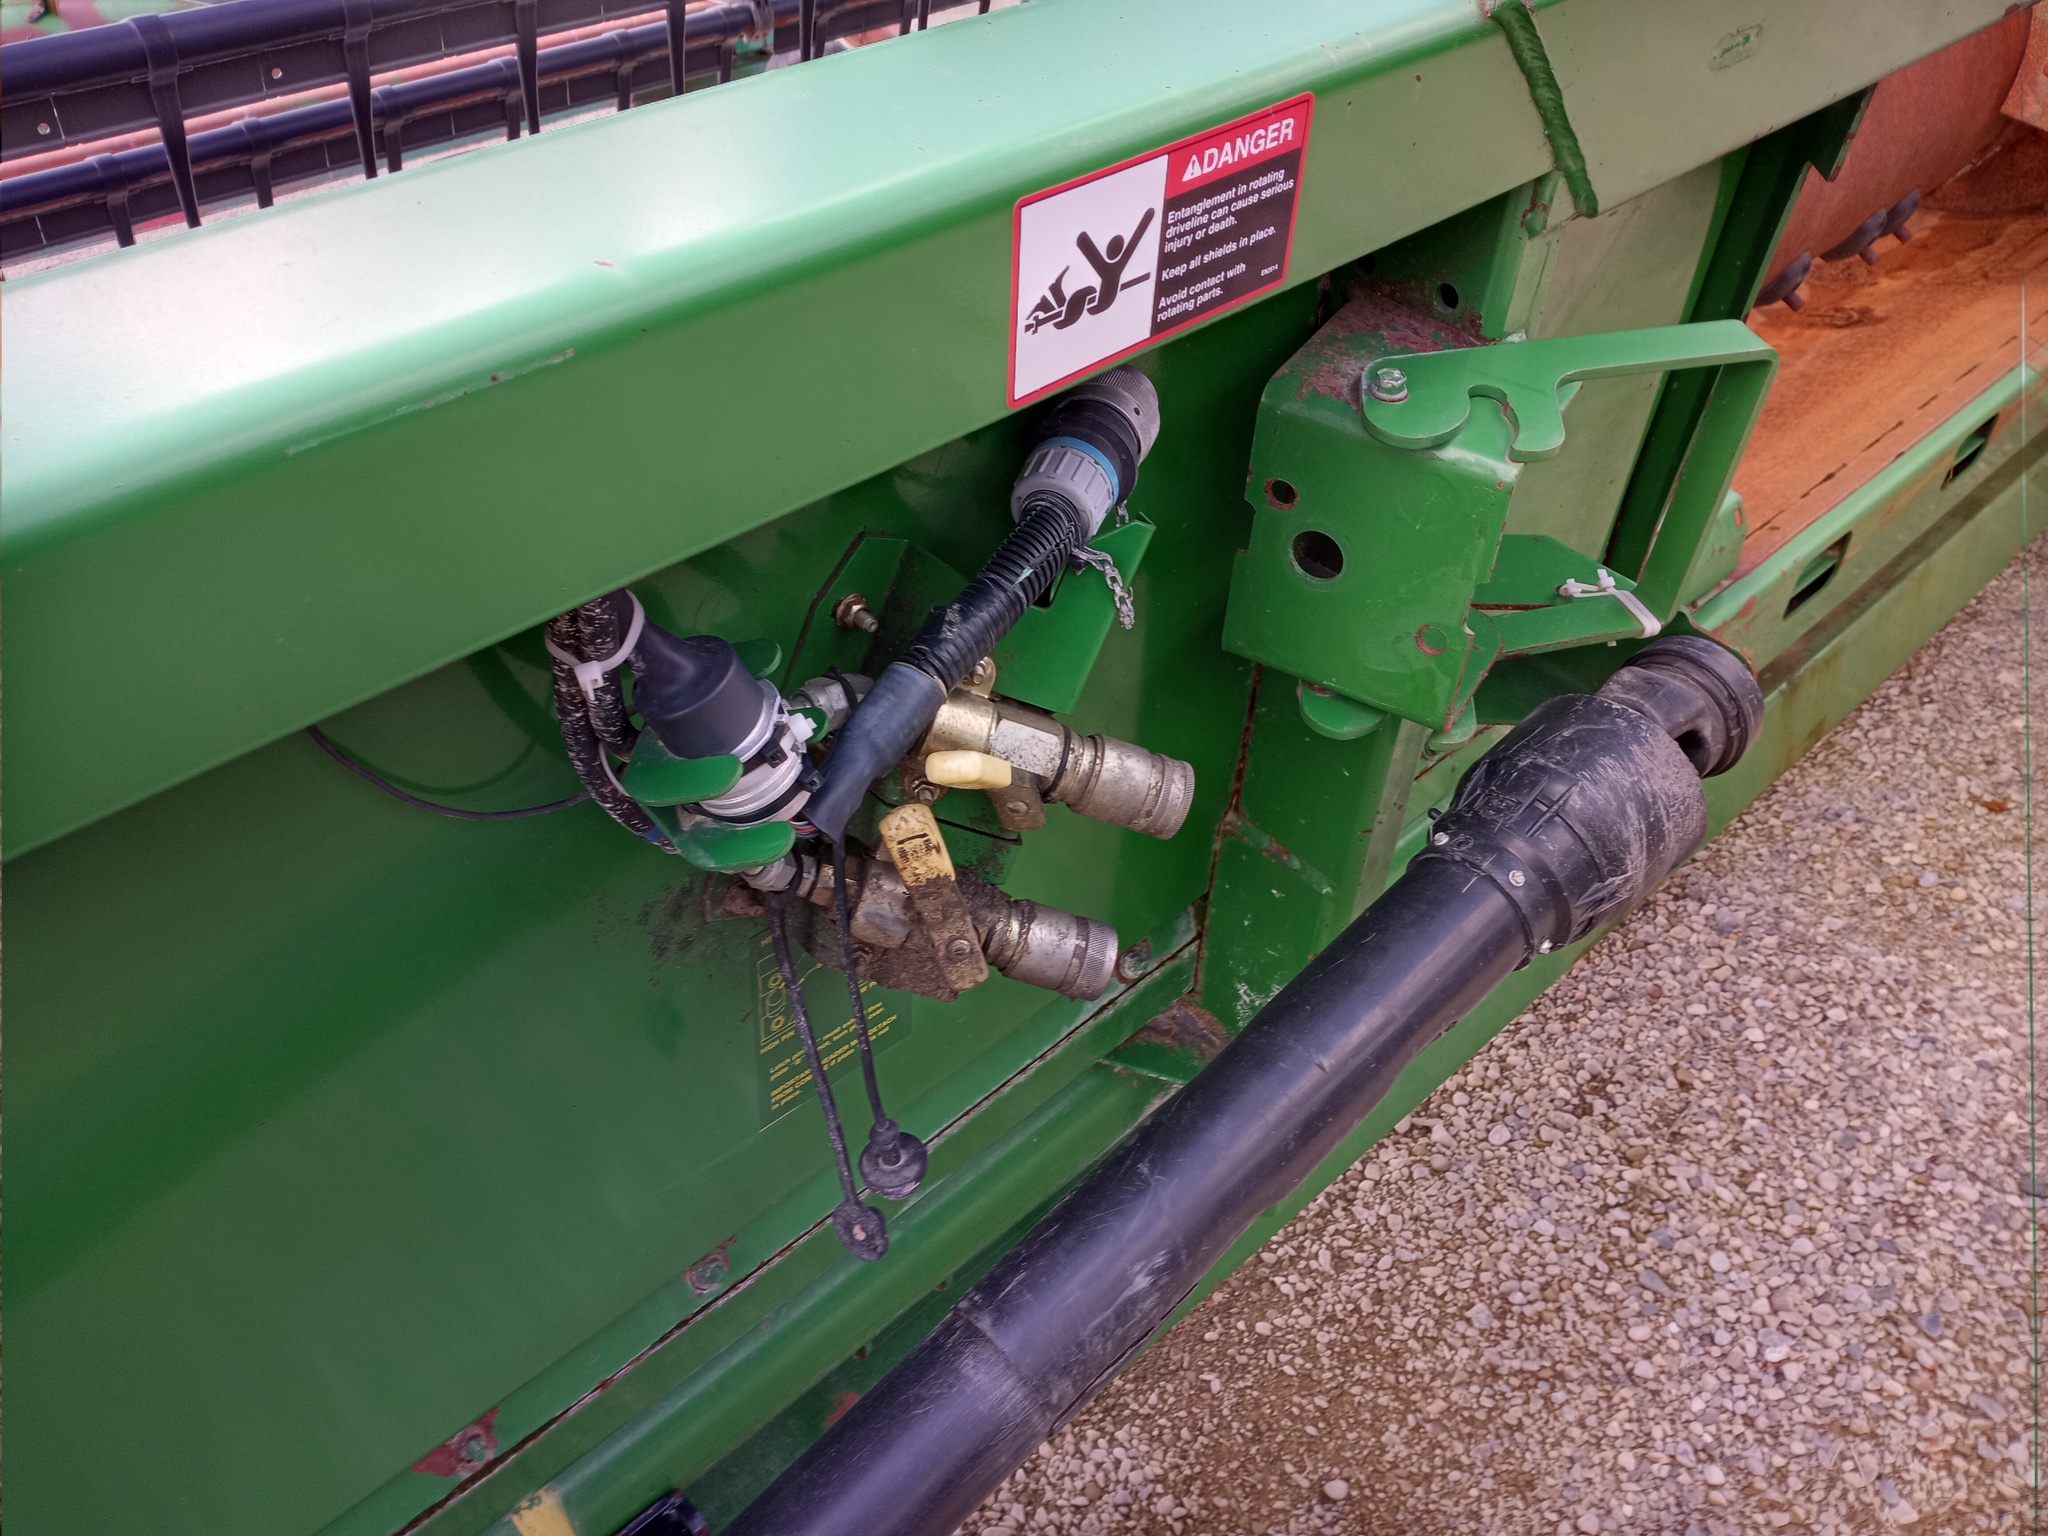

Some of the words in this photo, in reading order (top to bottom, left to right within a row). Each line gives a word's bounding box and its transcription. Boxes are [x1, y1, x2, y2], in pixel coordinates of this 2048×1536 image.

[1202, 117, 1295, 174] DANGER
[1166, 213, 1209, 238] driveline
[1211, 207, 1228, 220] can
[1231, 194, 1258, 212] cause
[1260, 178, 1294, 200] serious
[1168, 186, 1236, 224] Entanglement
[1237, 184, 1246, 194] in
[1249, 169, 1285, 191] rotating
[1161, 264, 1187, 281] Keep
[1189, 255, 1201, 269] all
[1203, 242, 1237, 264] shields
[1239, 237, 1248, 248] in
[1249, 226, 1276, 246] place.
[1164, 234, 1192, 253] injury
[1195, 228, 1206, 240] or
[1208, 215, 1237, 235] death.
[1157, 299, 1195, 322] rotating
[1196, 287, 1223, 307] parts.
[1158, 287, 1187, 309] Avoid
[1189, 271, 1225, 295] contact
[1226, 262, 1246, 279] with
